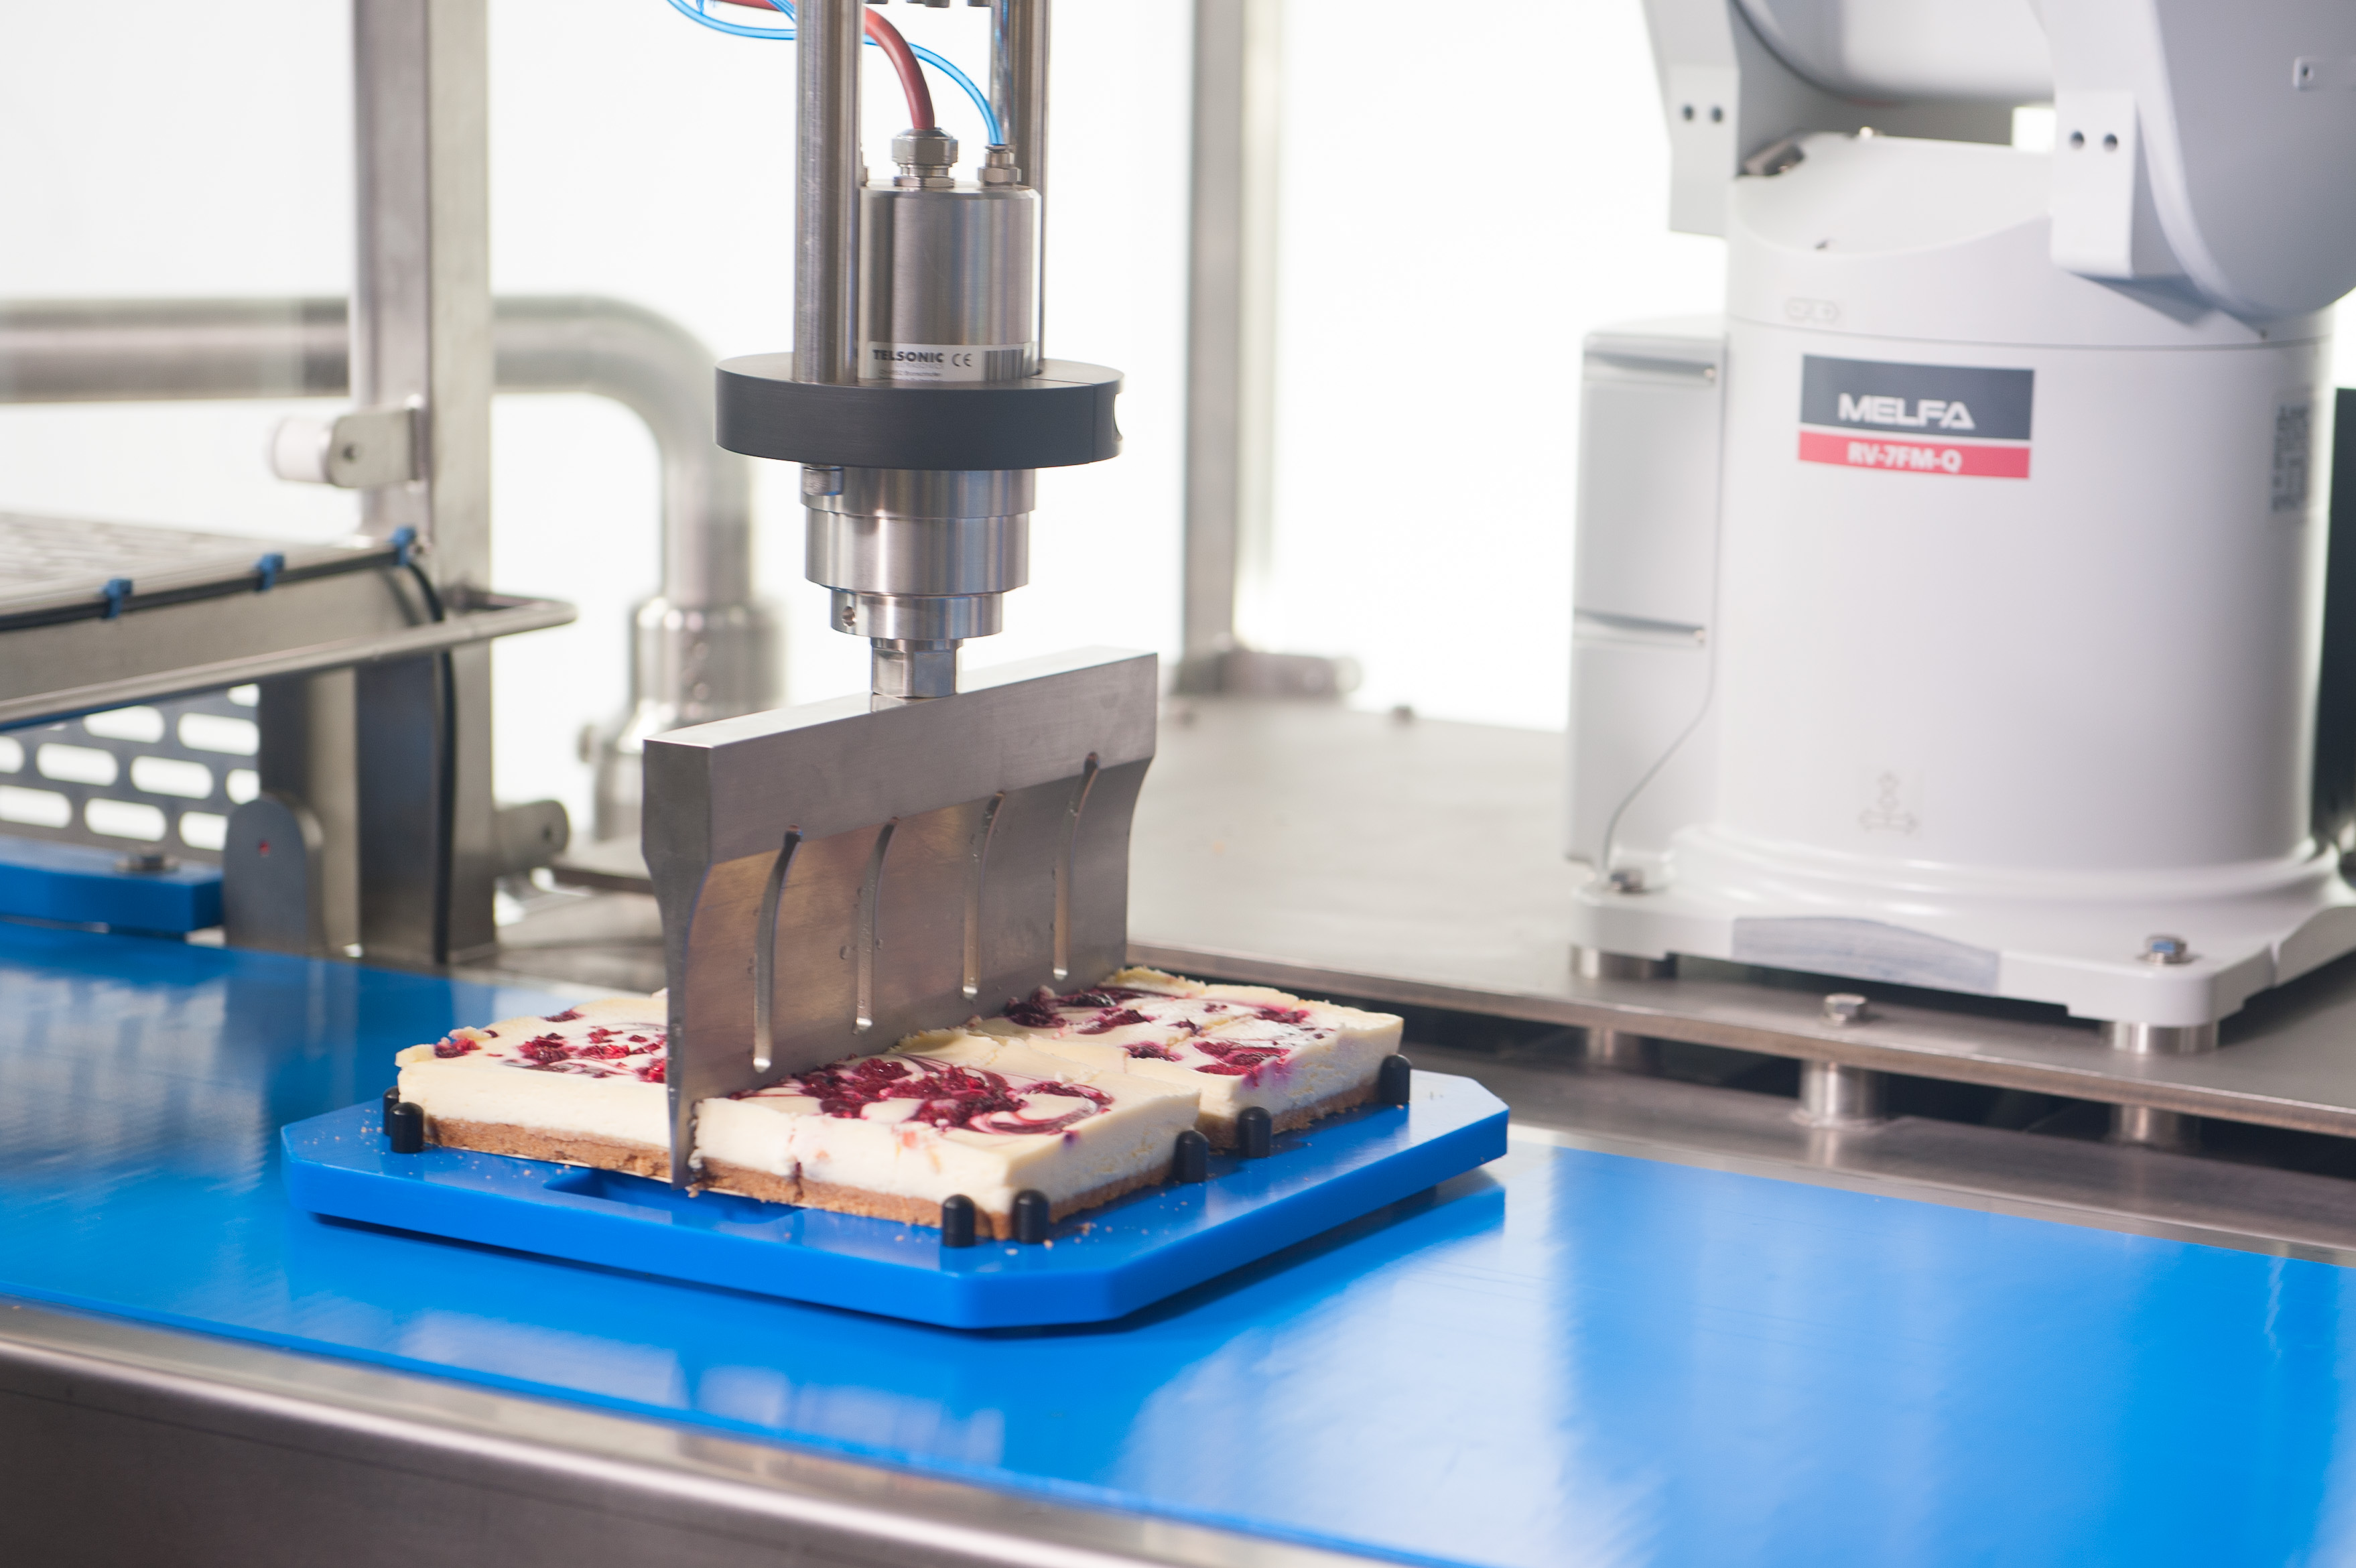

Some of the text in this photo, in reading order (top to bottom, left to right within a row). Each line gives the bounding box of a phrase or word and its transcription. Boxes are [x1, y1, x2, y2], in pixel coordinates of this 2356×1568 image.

[872, 349, 943, 363] TELSONIC
[952, 353, 972, 367] CE
[1839, 393, 1975, 430] MELFA
[1847, 441, 1963, 473] RV-7FM-Q
